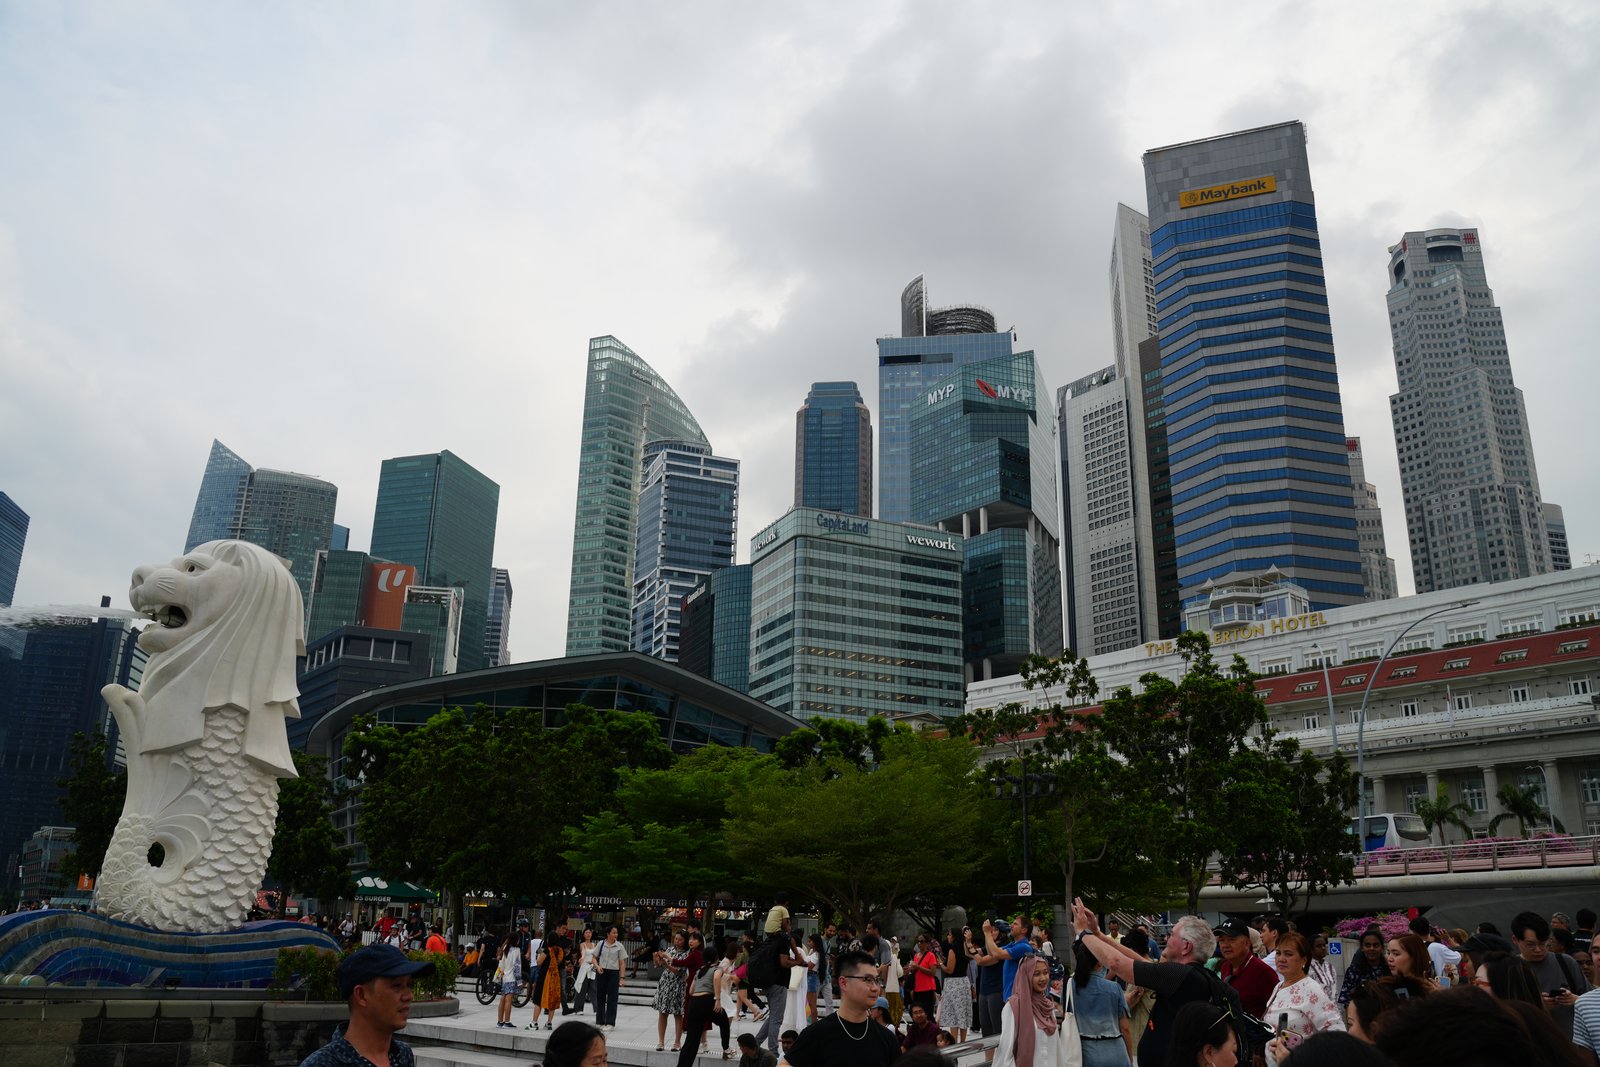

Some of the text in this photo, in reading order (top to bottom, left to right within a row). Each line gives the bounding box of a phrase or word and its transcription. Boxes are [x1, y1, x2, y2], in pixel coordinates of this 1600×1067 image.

[1200, 180, 1267, 200] Maybank
[928, 384, 954, 406] MYP
[997, 385, 1031, 402] MYP
[816, 513, 869, 534] CapitaLand
[906, 534, 956, 551] wework
[64, 618, 88, 626] MUFG
[1145, 641, 1173, 657] THE
[1271, 612, 1327, 633] HOTEL
[585, 896, 622, 905] HOTDOG
[634, 898, 666, 907] COFFEE
